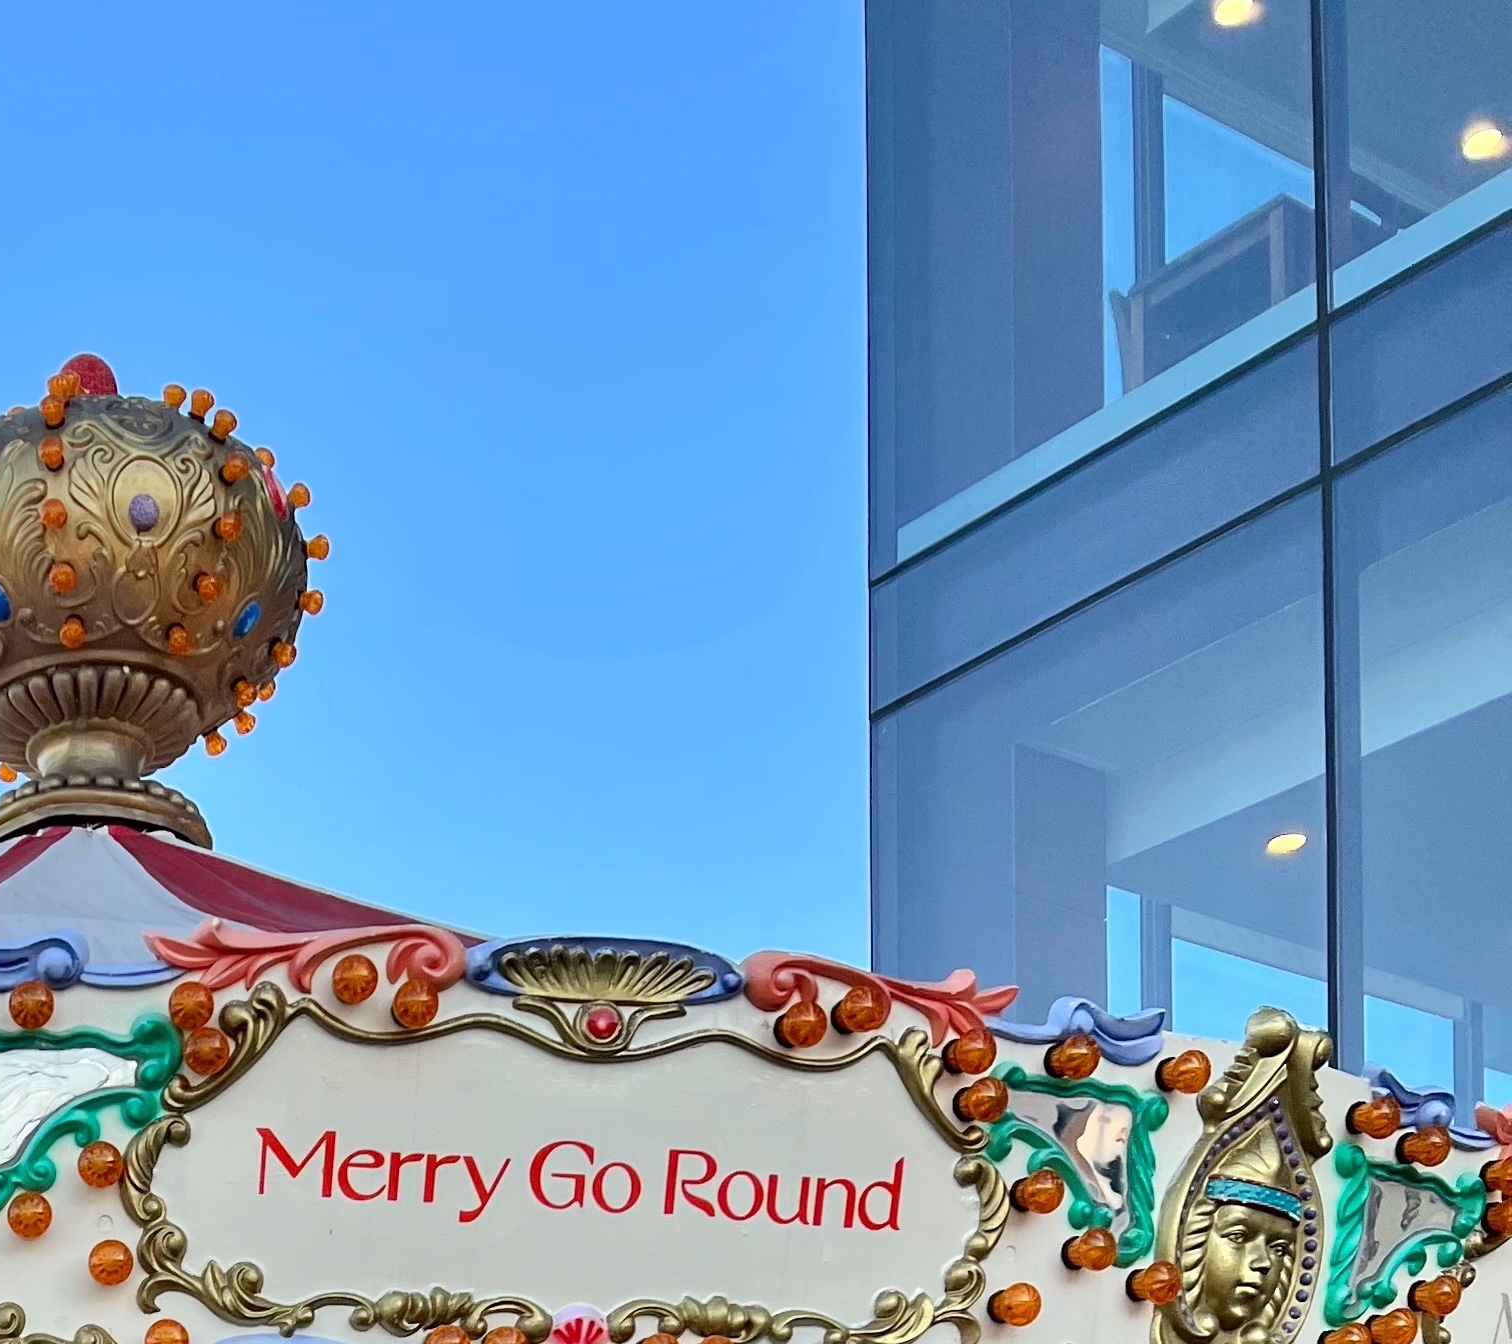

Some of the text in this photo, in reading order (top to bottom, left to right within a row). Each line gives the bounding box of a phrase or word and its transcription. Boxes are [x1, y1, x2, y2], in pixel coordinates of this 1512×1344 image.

[256, 1127, 906, 1232] Merry Go Round
